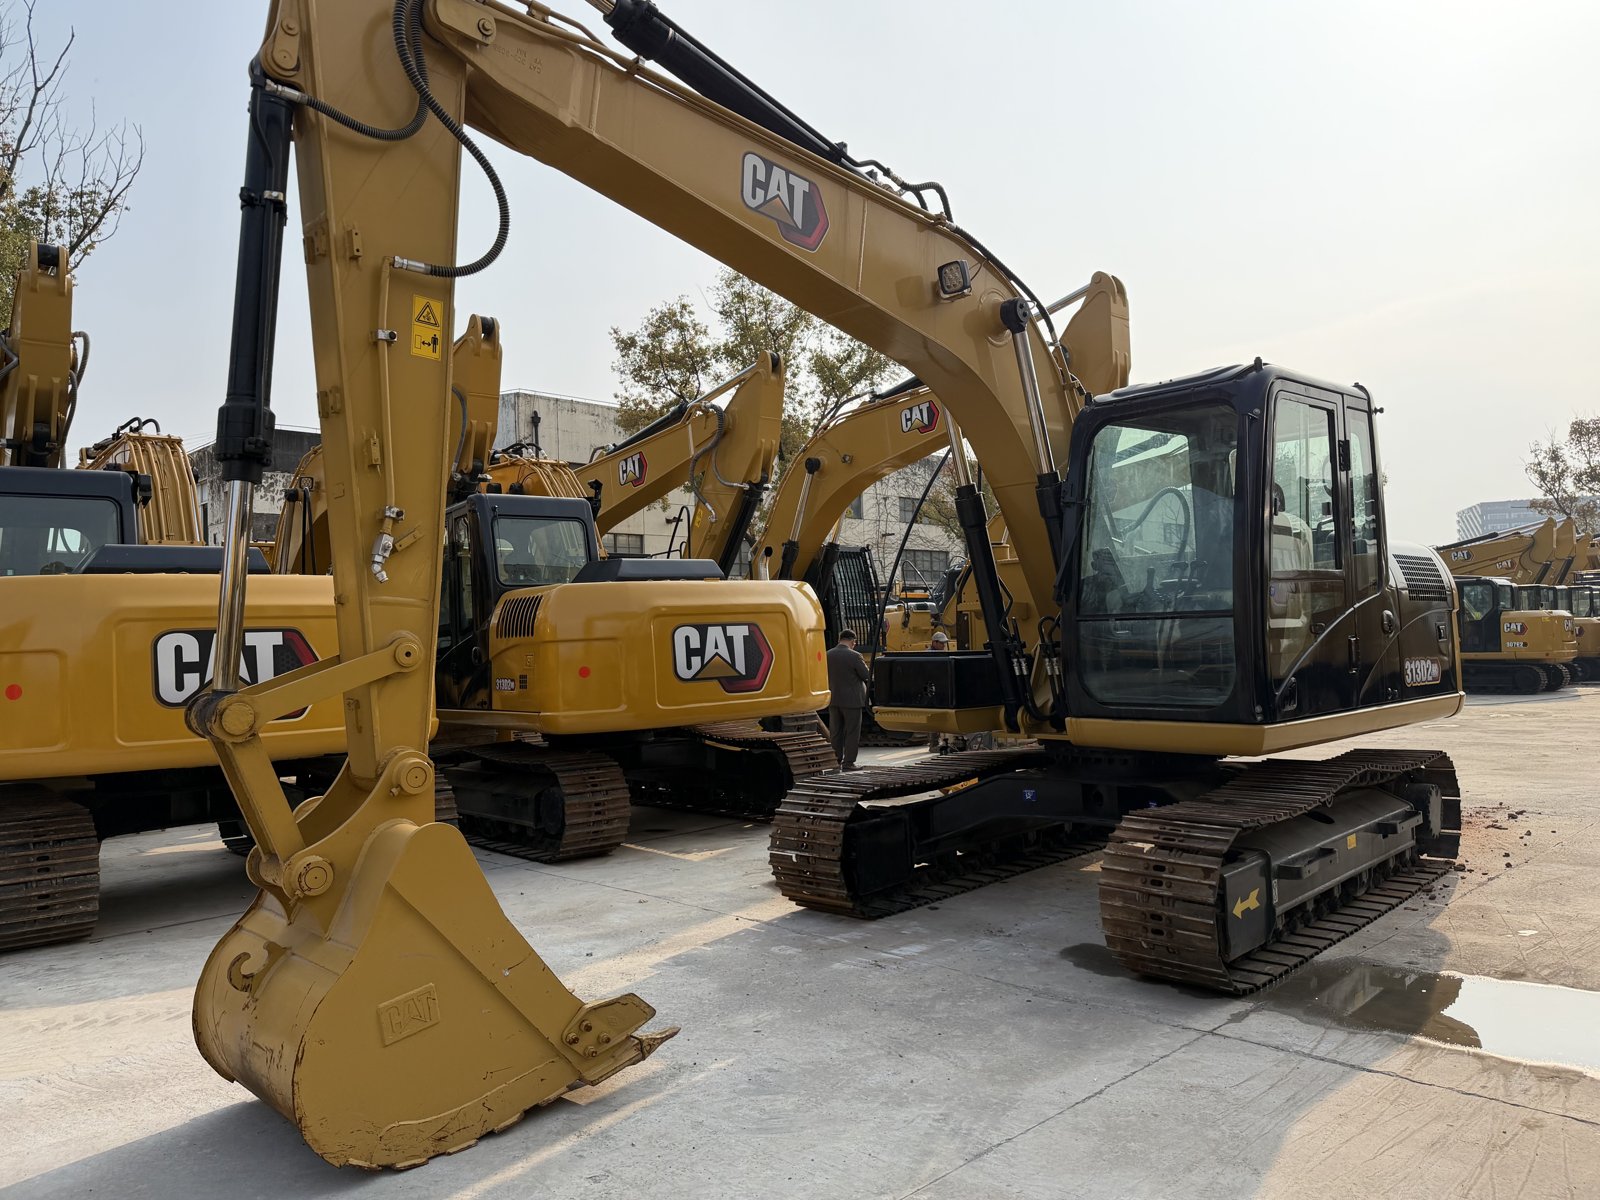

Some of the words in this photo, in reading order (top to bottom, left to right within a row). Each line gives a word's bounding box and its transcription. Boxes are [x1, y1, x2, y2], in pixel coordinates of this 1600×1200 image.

[743, 153, 809, 229] CAT
[901, 402, 930, 432] CAT
[619, 453, 640, 485] CAT
[1451, 550, 1468, 561] CAT
[1496, 559, 1512, 570] CAT
[1504, 622, 1522, 633] CAT
[156, 631, 284, 703] CT
[674, 625, 750, 679] CAT
[1405, 659, 1432, 683] 313D2
[384, 990, 436, 1038] CAT
